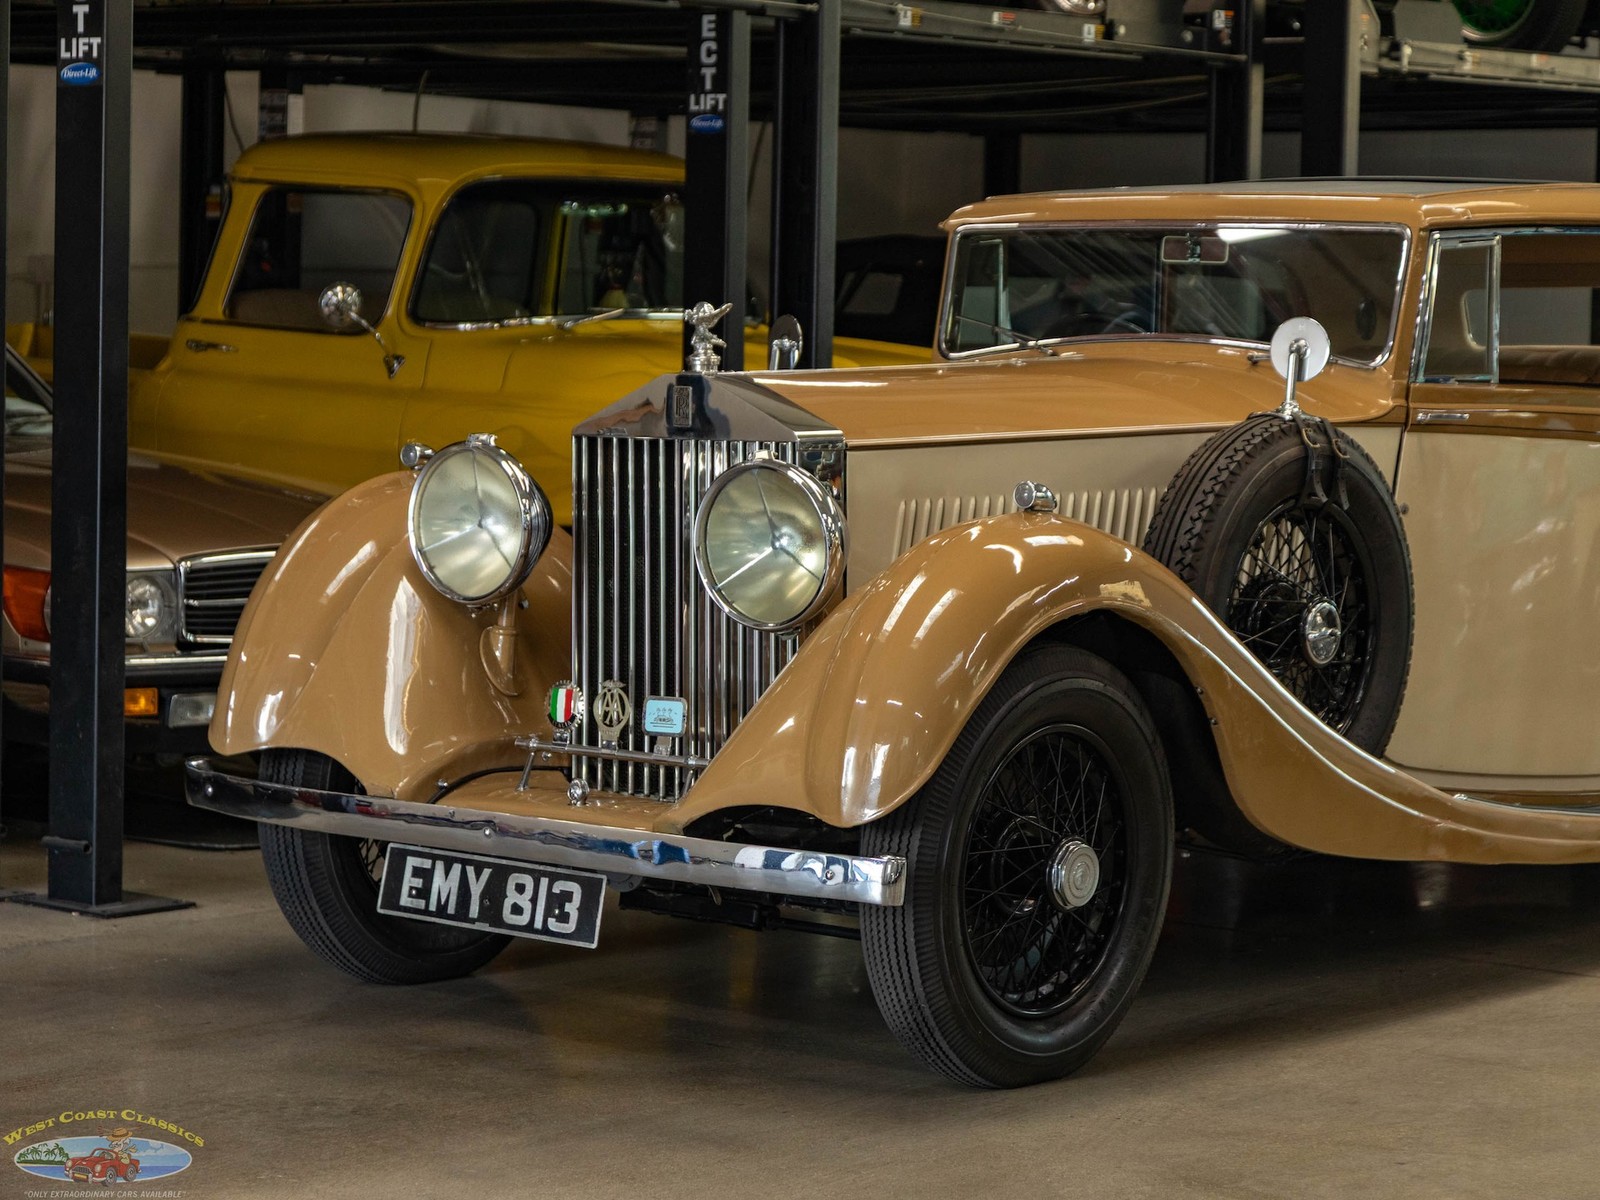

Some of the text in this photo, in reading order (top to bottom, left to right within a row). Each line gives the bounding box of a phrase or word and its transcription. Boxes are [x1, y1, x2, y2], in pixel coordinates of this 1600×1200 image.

[60, 37, 101, 59] LIFT
[689, 93, 727, 111] LIFT
[399, 855, 583, 934] EMY 813
